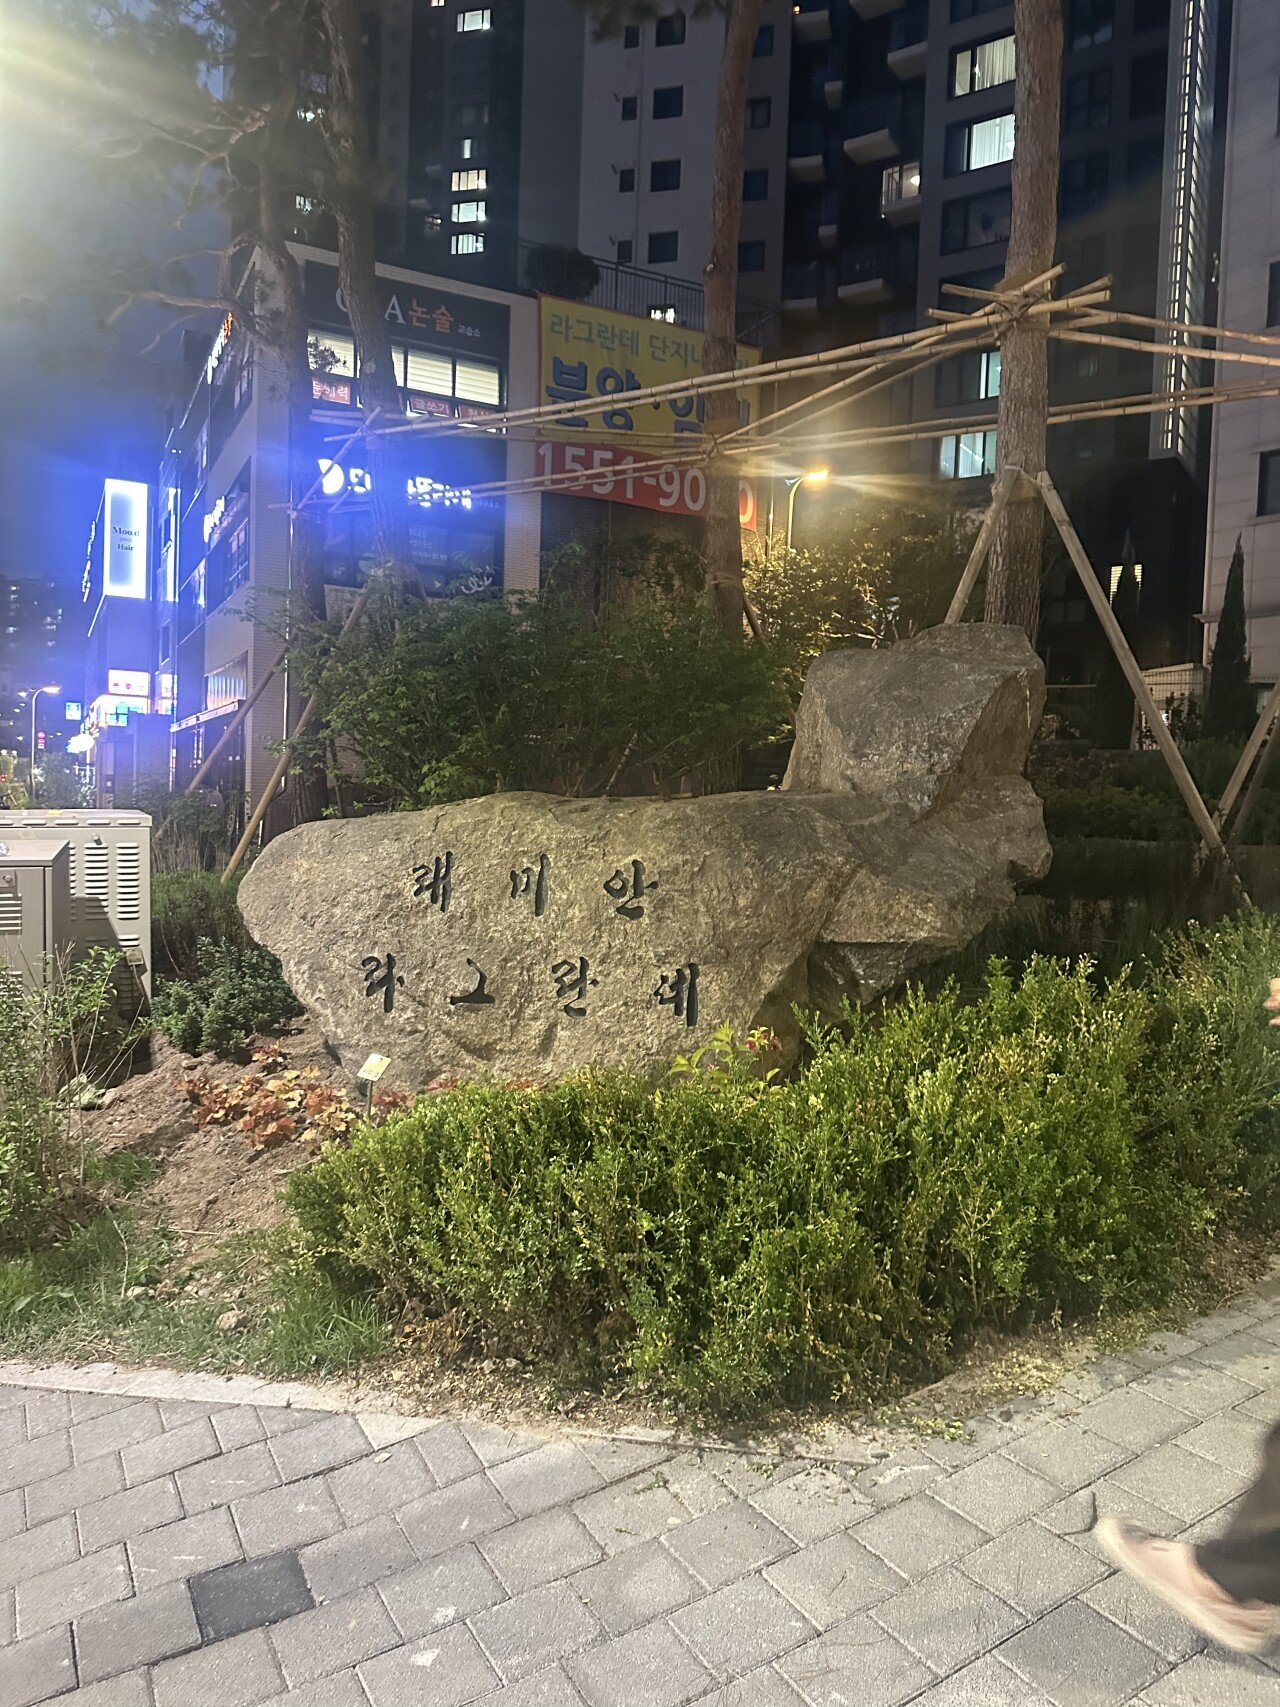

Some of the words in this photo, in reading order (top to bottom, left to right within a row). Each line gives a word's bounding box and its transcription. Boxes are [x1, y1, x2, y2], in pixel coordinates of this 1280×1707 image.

[550, 314, 639, 357] 라그란데
[538, 443, 753, 523] 1551-900
[117, 543, 135, 552] Hair
[412, 851, 659, 920] 래미안
[362, 953, 699, 1028] 라그란데
